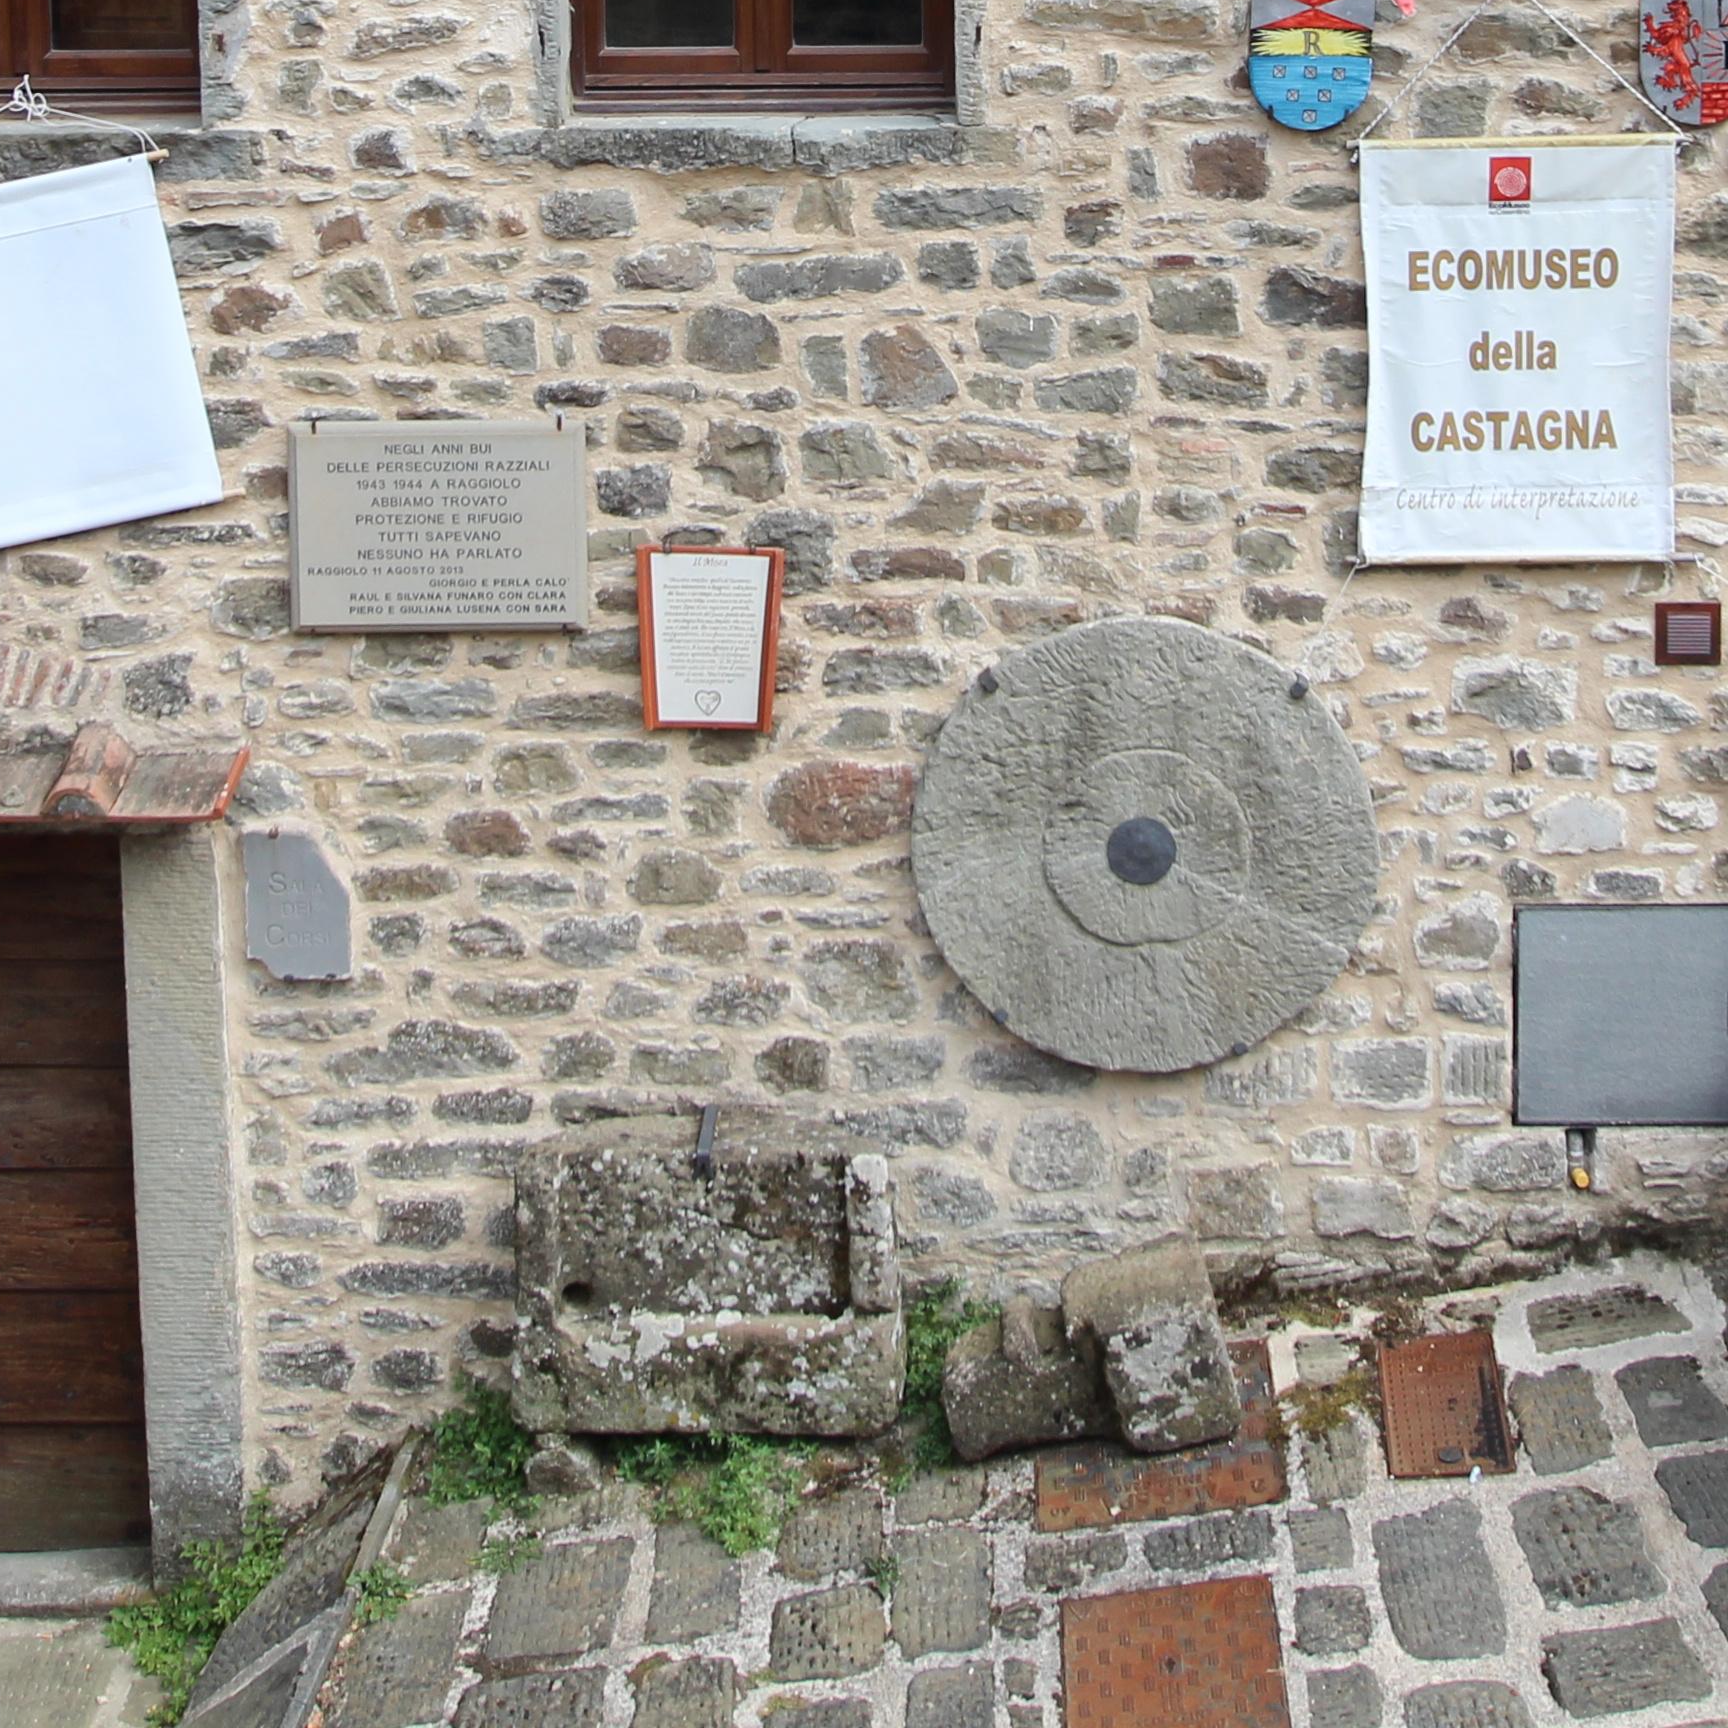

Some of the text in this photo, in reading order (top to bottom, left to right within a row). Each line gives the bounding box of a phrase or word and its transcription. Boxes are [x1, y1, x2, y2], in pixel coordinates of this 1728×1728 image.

[1303, 30, 1324, 56] R
[1407, 248, 1619, 291] ECOMUSEO
[1469, 331, 1557, 371] della
[1410, 409, 1618, 452] CASTAGNA
[384, 443, 492, 455] NEGLI ANNI BUI
[327, 460, 550, 473] DELLE PERSECUZIONI RAZZIALI
[356, 478, 521, 490] 1943 1944 A RAGGIOLO
[371, 495, 508, 507] ABBIAMO TROVATO
[1396, 485, 1640, 520] Centro di interpretazione
[355, 513, 523, 525] PROTEZIONE E RIFUGIO
[378, 530, 501, 542] TUTTI SAPEVANO
[357, 547, 523, 560] NESSUNO HA PARLATO
[307, 565, 464, 576] RAGGIOLO 11 AGOSTO 2013
[429, 578, 477, 588] GIORGIO
[481, 578, 489, 587] E
[493, 578, 530, 587] PERLA
[349, 591, 566, 602] RAUL E SILVANA FUNARO CON CLARA
[349, 604, 567, 615] PIERO E GIULIANA LUSENA CON SARA
